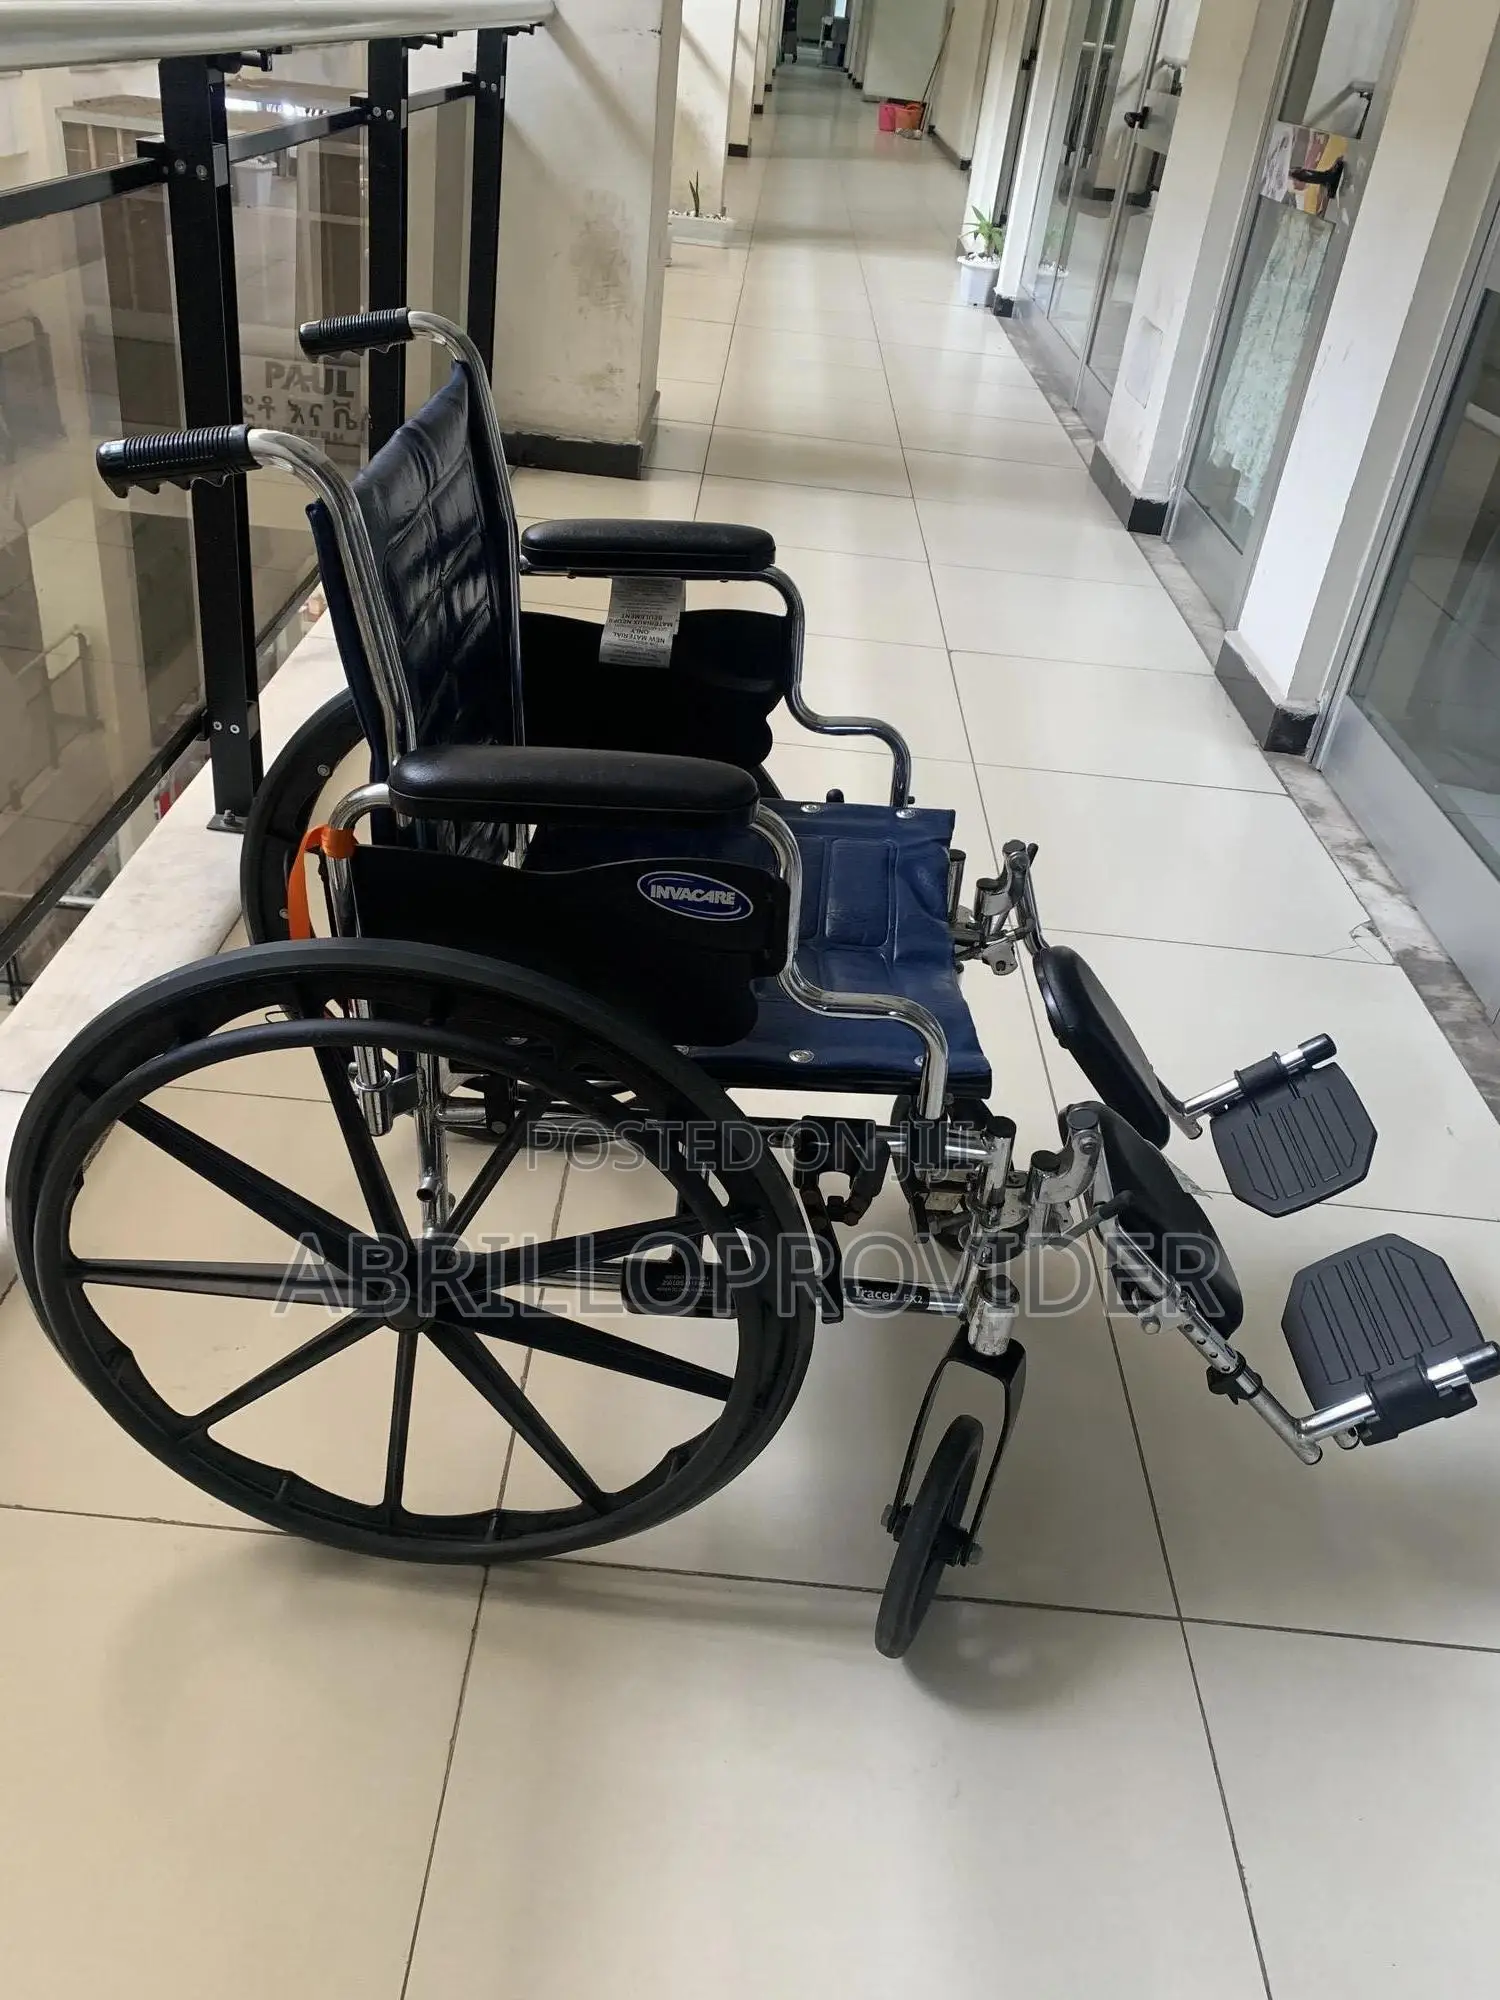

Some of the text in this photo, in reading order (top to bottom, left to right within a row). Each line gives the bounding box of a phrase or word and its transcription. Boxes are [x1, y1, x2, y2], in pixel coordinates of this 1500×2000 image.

[265, 361, 355, 398] PAUL
[612, 631, 666, 644] NEW MATERIAL
[650, 884, 736, 906] INVACARE
[853, 1285, 923, 1304] Tracer EX2
